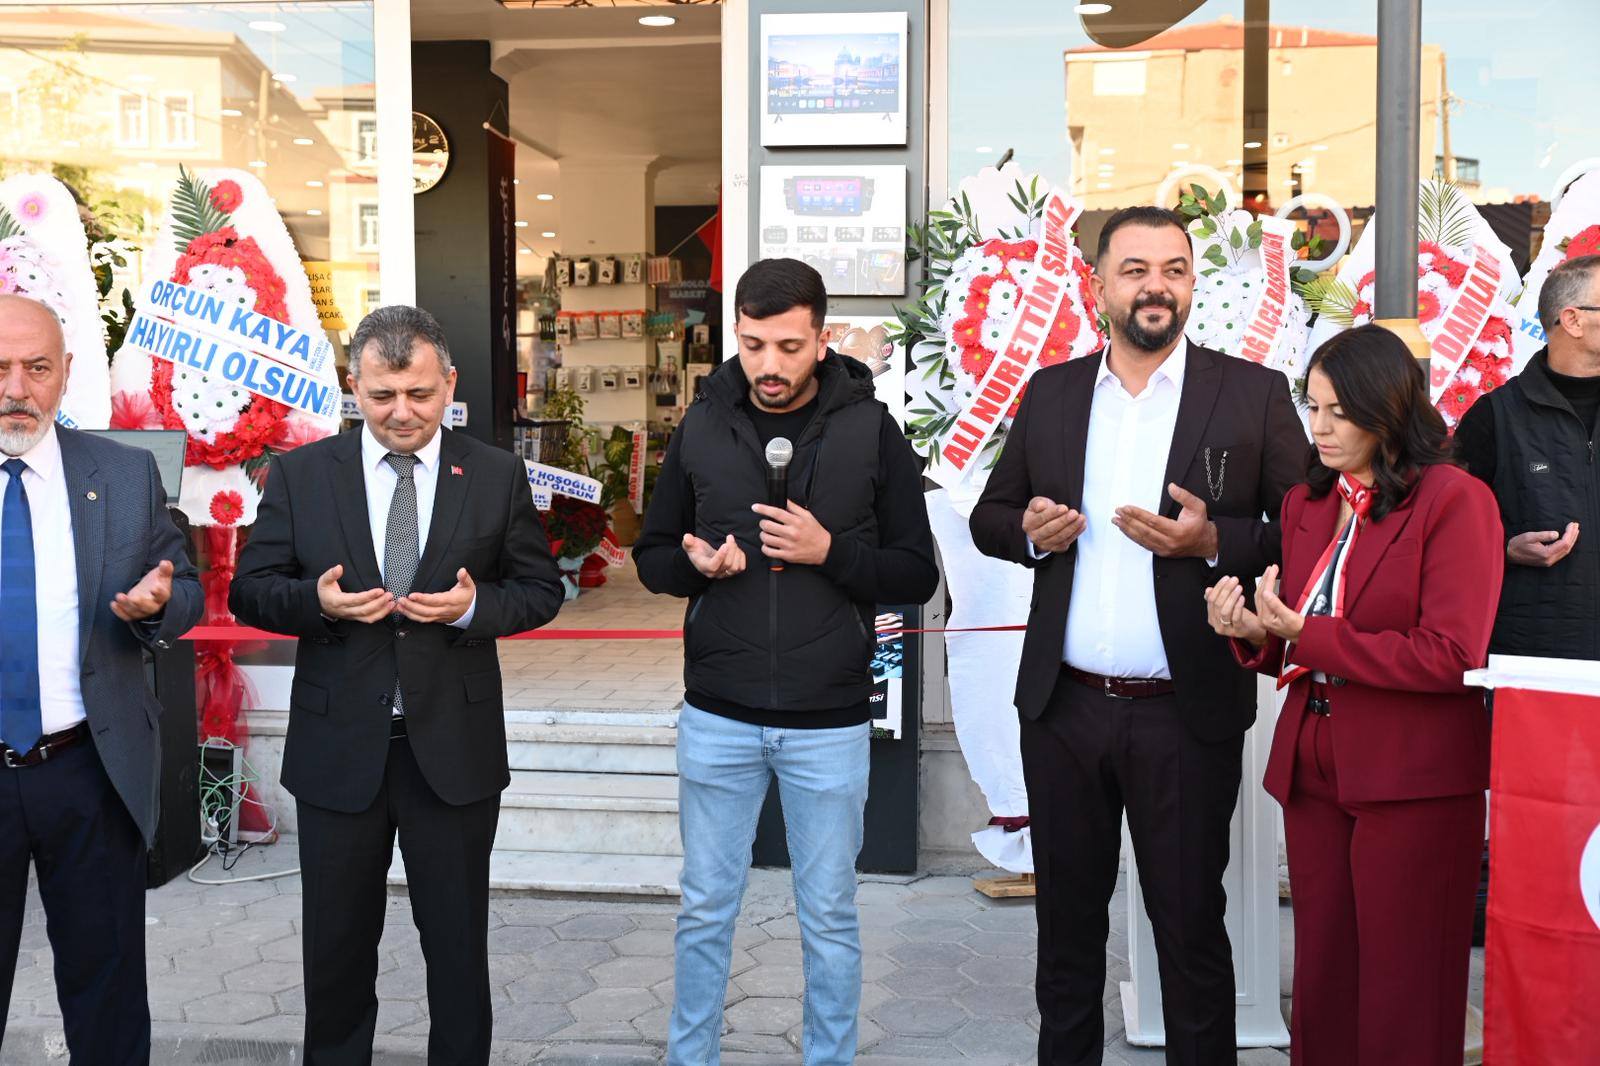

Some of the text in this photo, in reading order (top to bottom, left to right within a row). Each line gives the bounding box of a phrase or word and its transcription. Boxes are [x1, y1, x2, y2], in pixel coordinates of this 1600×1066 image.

[151, 280, 225, 324] ORÇUN
[228, 307, 310, 361] KAYA
[1248, 299, 1284, 340] İLÇE
[1431, 273, 1497, 363] DAMLA
[129, 316, 218, 372] HAYIRLI
[222, 351, 328, 414] OLSUN
[943, 419, 985, 471] ALİ
[969, 276, 1060, 424] NURETTİN
[1241, 334, 1271, 364] AĞ
[527, 476, 594, 500] RLI OLSUN
[538, 471, 597, 493] HOŞOĞLU
